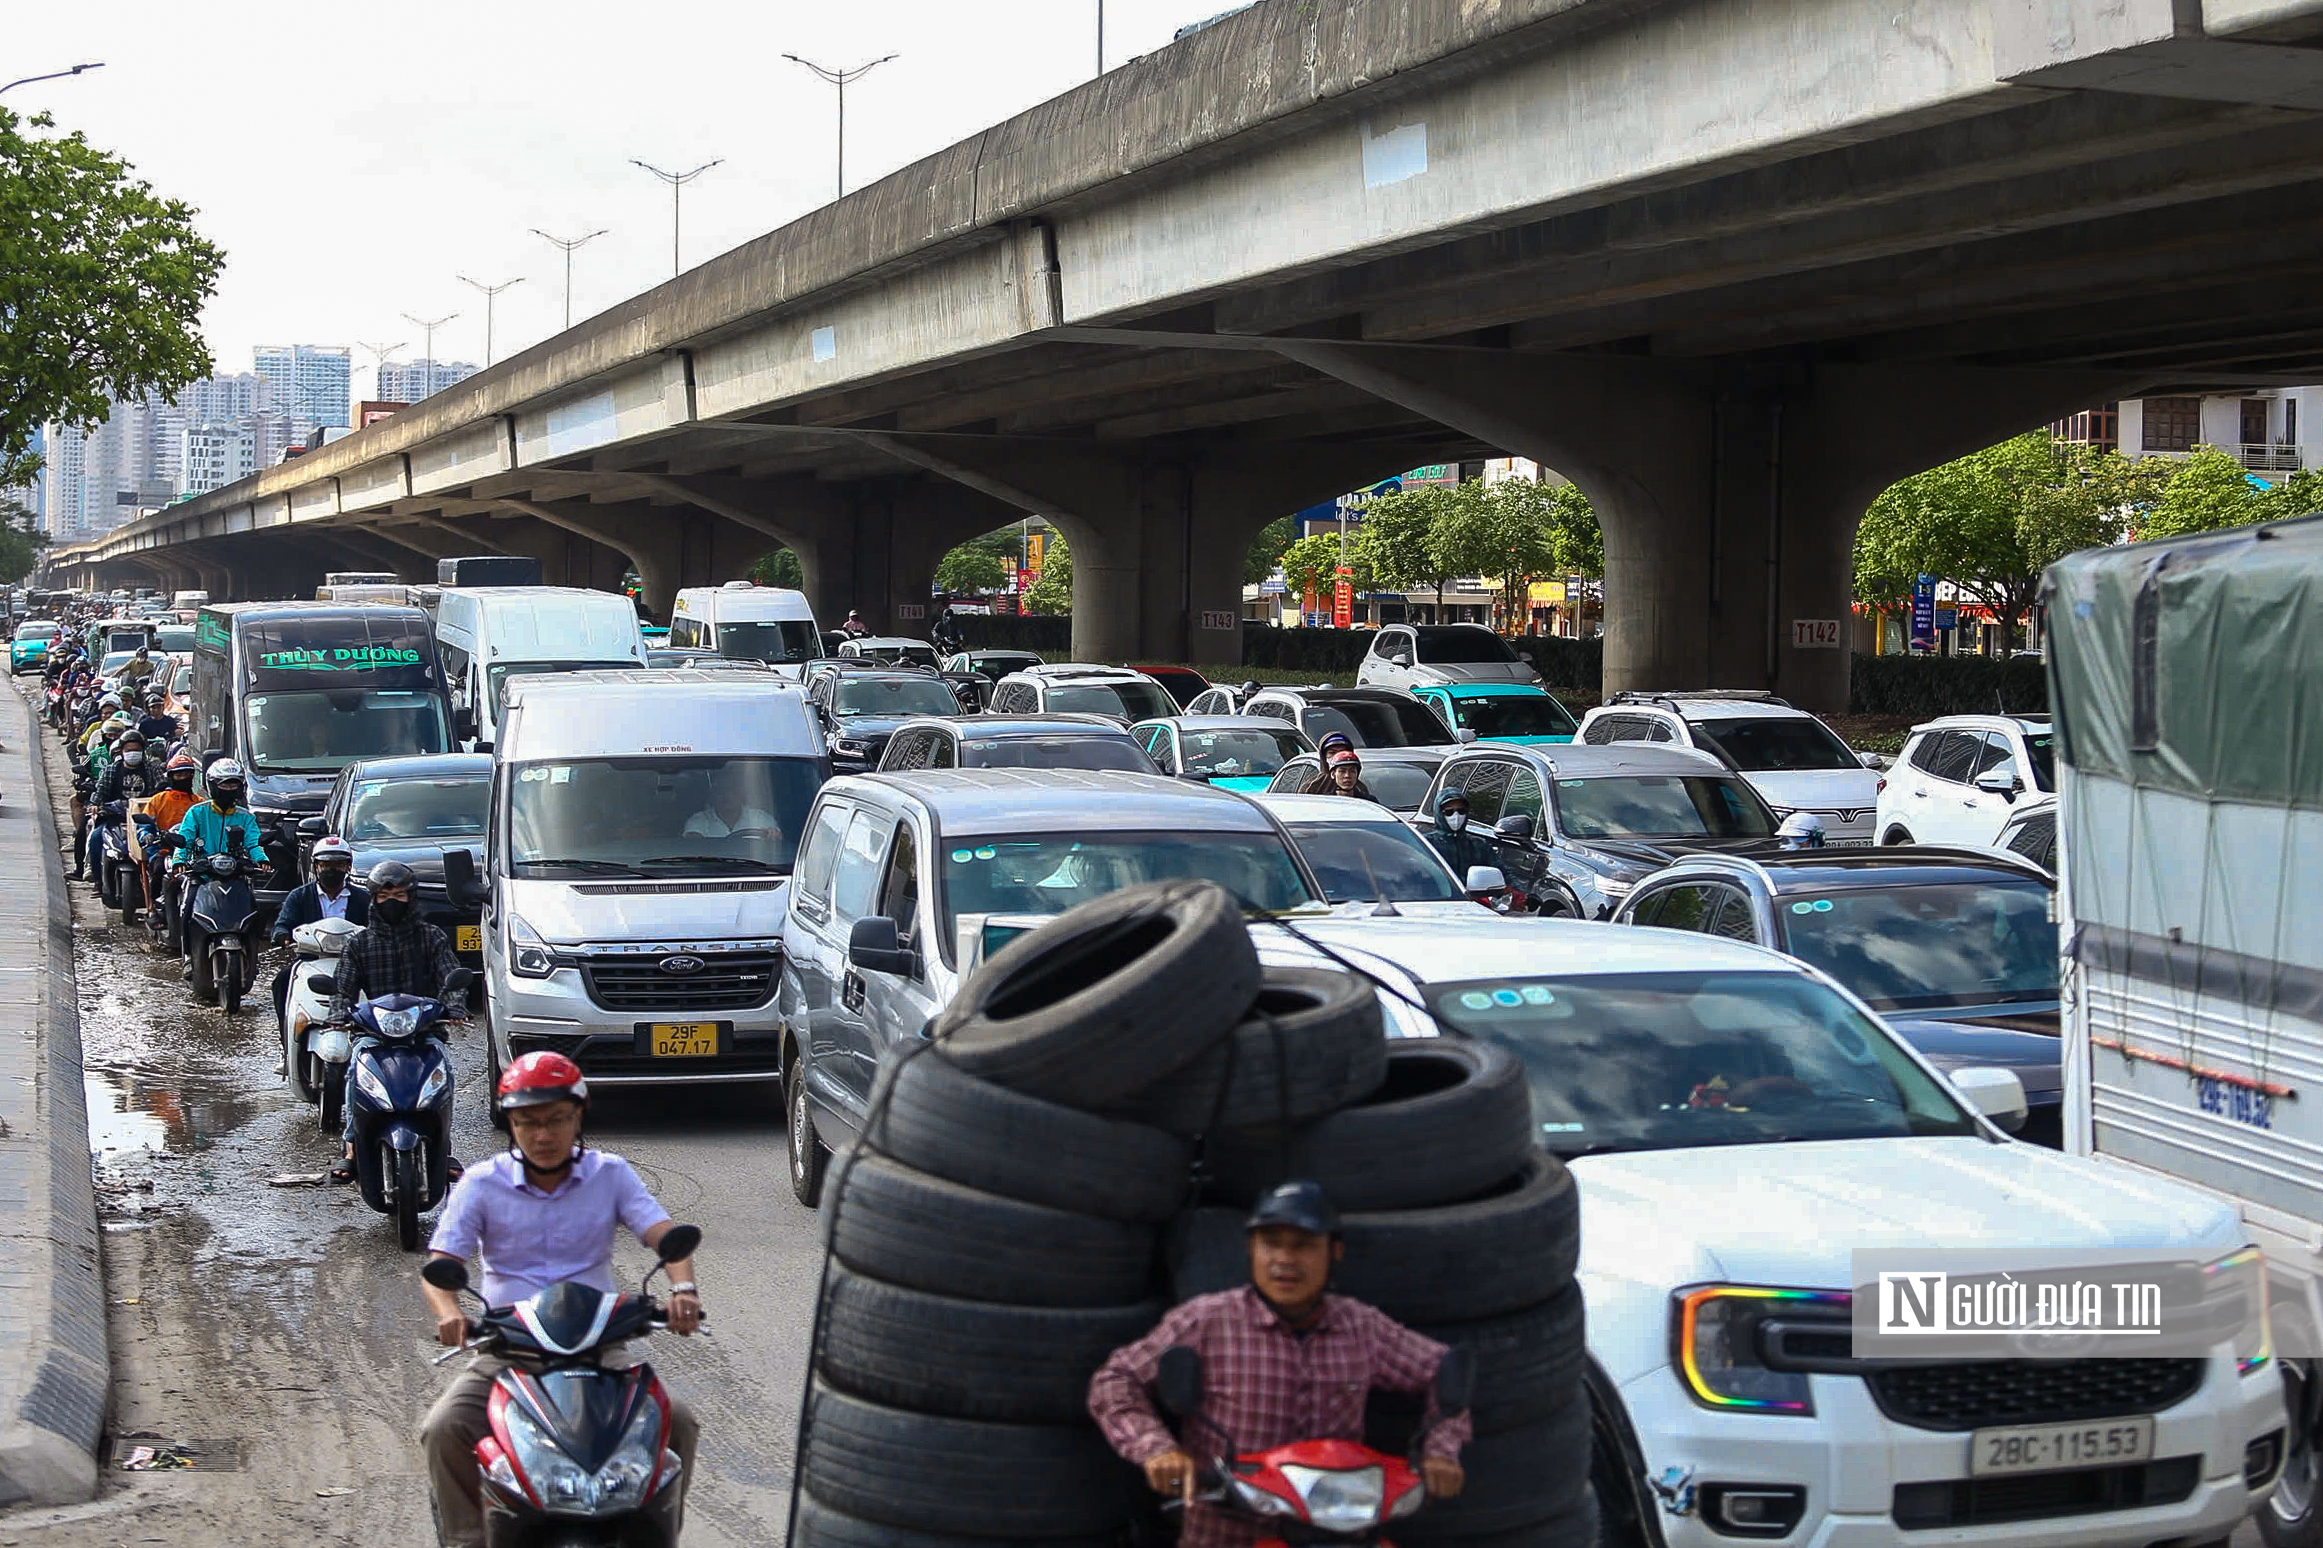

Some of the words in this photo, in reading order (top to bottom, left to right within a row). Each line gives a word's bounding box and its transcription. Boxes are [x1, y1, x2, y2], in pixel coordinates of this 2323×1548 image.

[1203, 612, 1233, 629] T143
[1797, 621, 1837, 644] T142
[333, 646, 420, 662] DƯƠNG
[598, 941, 769, 953] TRANSIT
[670, 958, 695, 970] Ford
[670, 1025, 699, 1040] 29F
[659, 1040, 711, 1054] 047.17
[1988, 1426, 2139, 1467] 28C-115.53
